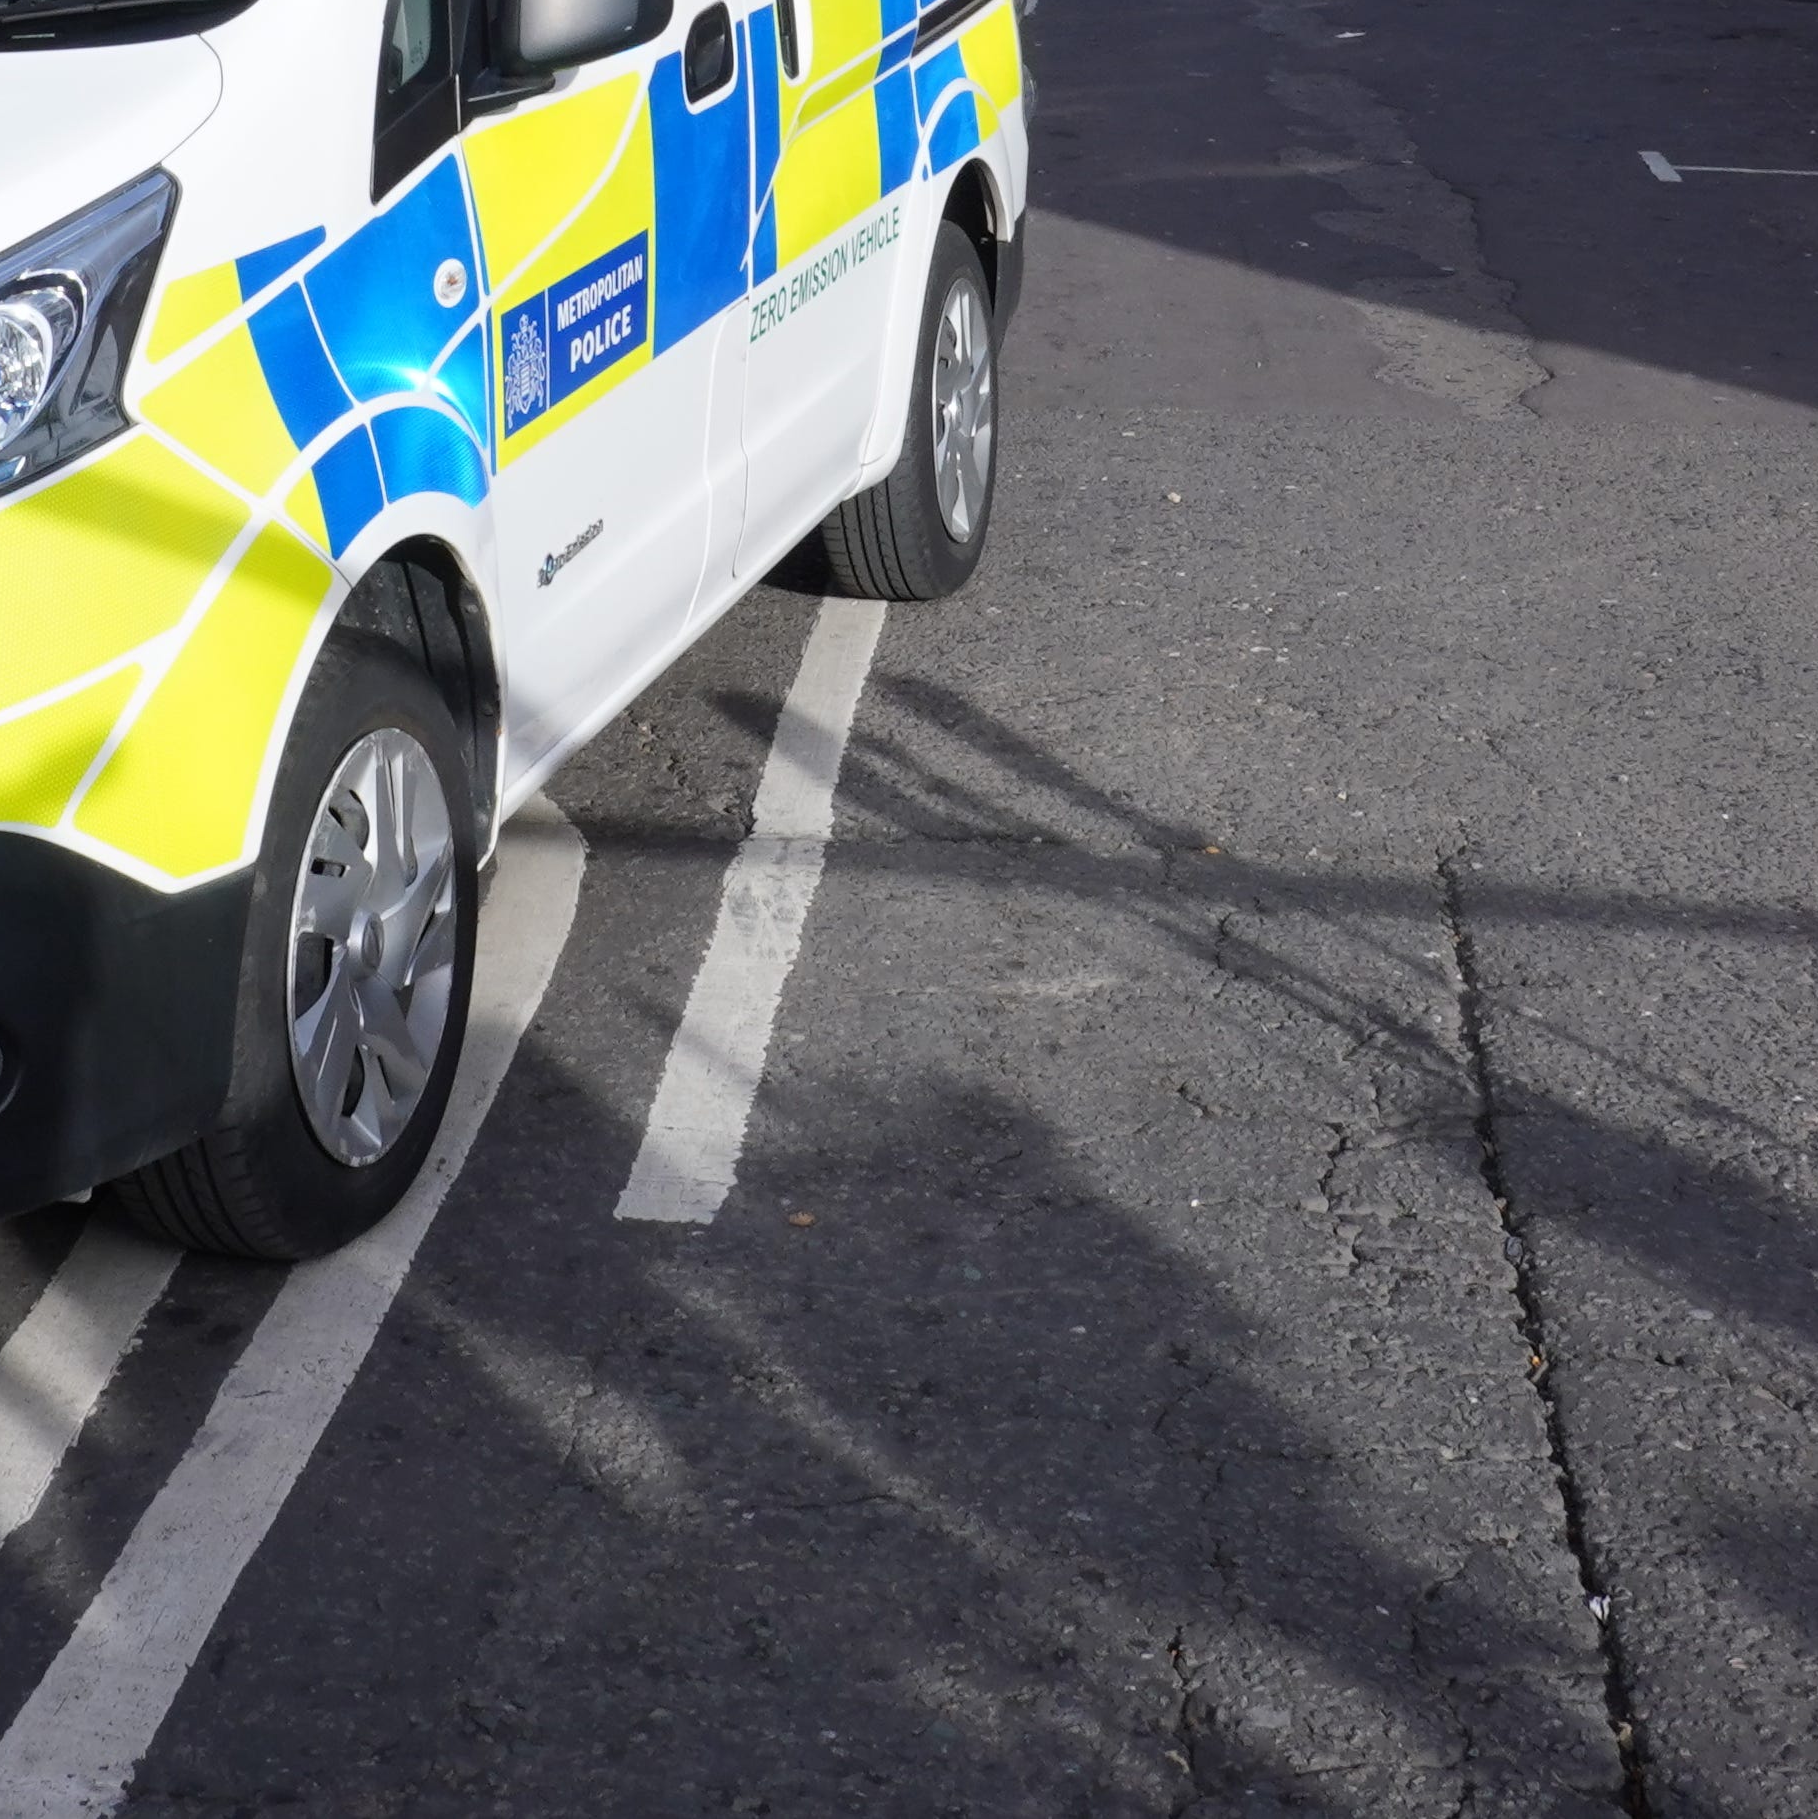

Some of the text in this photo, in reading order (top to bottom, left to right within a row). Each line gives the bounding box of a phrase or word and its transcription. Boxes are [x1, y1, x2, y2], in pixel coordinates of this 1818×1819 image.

[557, 253, 643, 333] METROPOLITAN
[749, 205, 900, 344] ZERO EMISSION VEHICLE
[570, 303, 632, 374] POLICE
